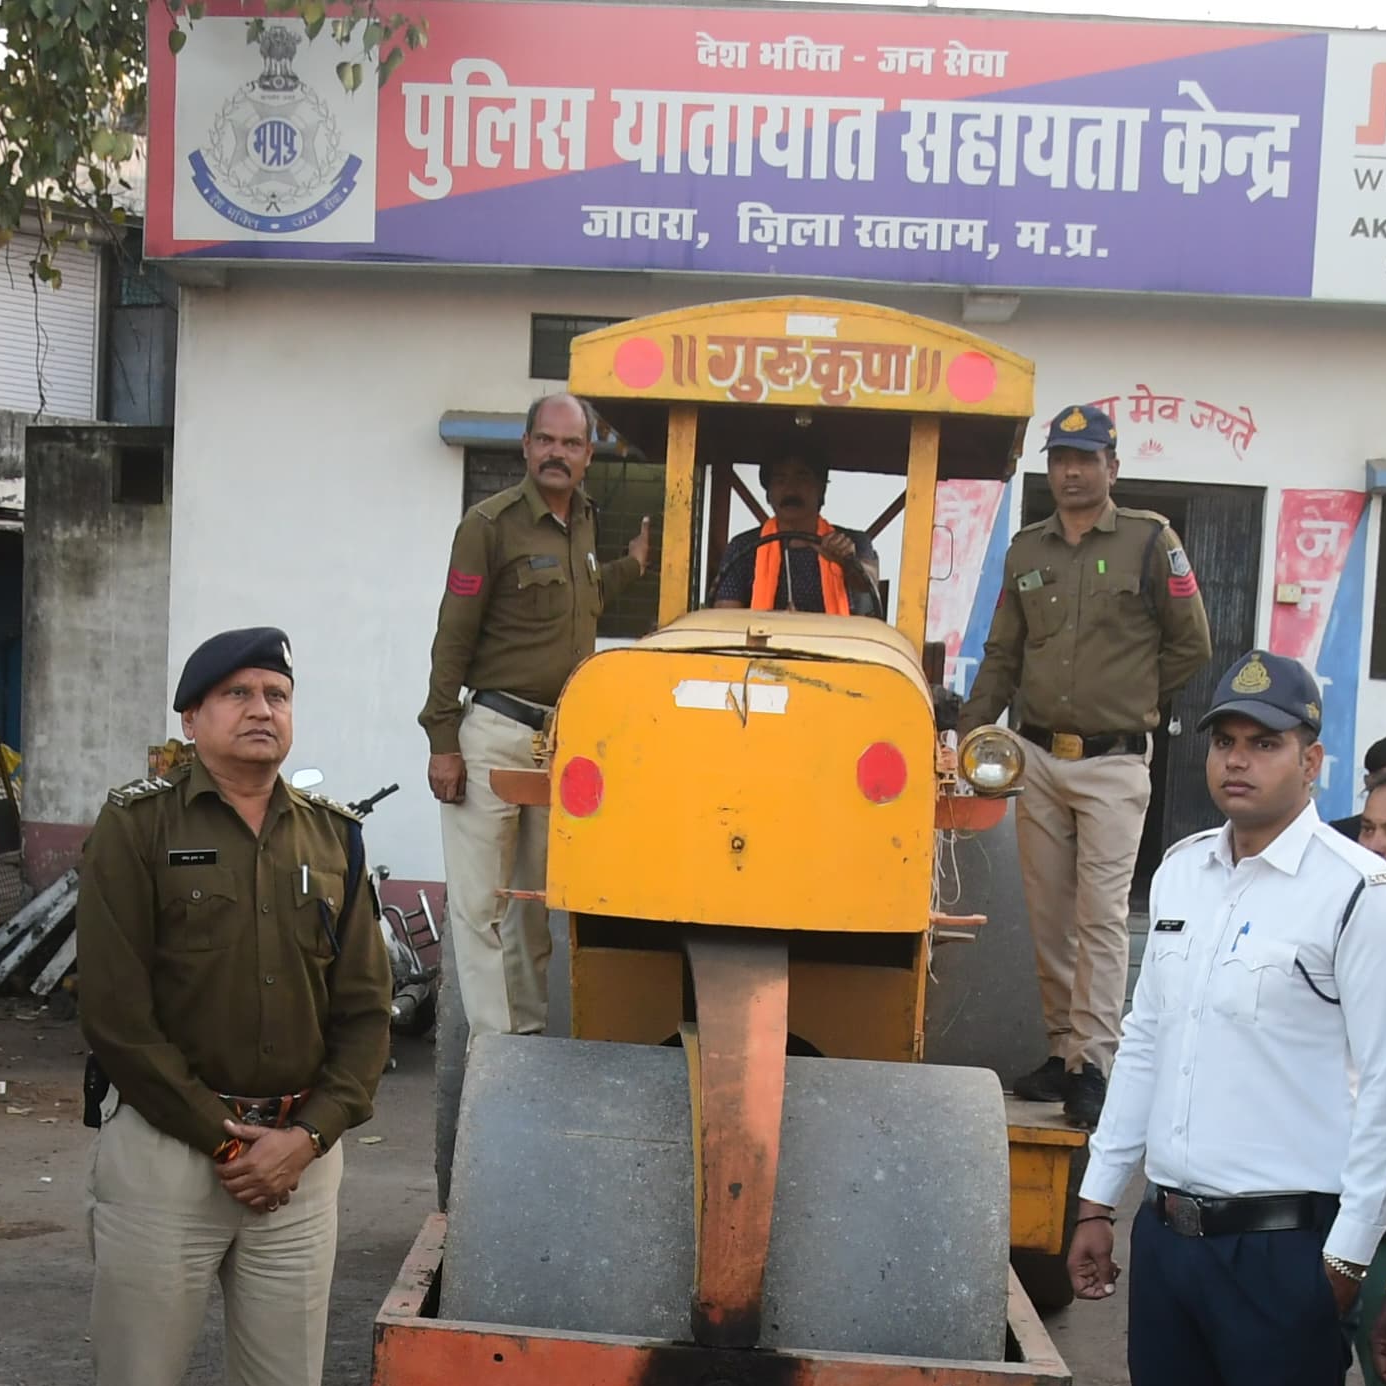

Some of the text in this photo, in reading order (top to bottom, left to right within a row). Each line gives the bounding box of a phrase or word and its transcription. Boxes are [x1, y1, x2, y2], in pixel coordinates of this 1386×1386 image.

[696, 32, 750, 69] देश
[759, 36, 844, 72] भक्ति
[877, 46, 935, 76] जन
[944, 41, 1008, 78] सेवा
[402, 58, 1300, 202] पुलिस यातायात सहायता केन्द्र
[581, 205, 709, 249] जावरा,
[854, 215, 1000, 260] रतलाम,
[1015, 221, 1109, 258] म.प्र.
[1128, 384, 1185, 423] मेव
[1190, 400, 1258, 461] जयते
